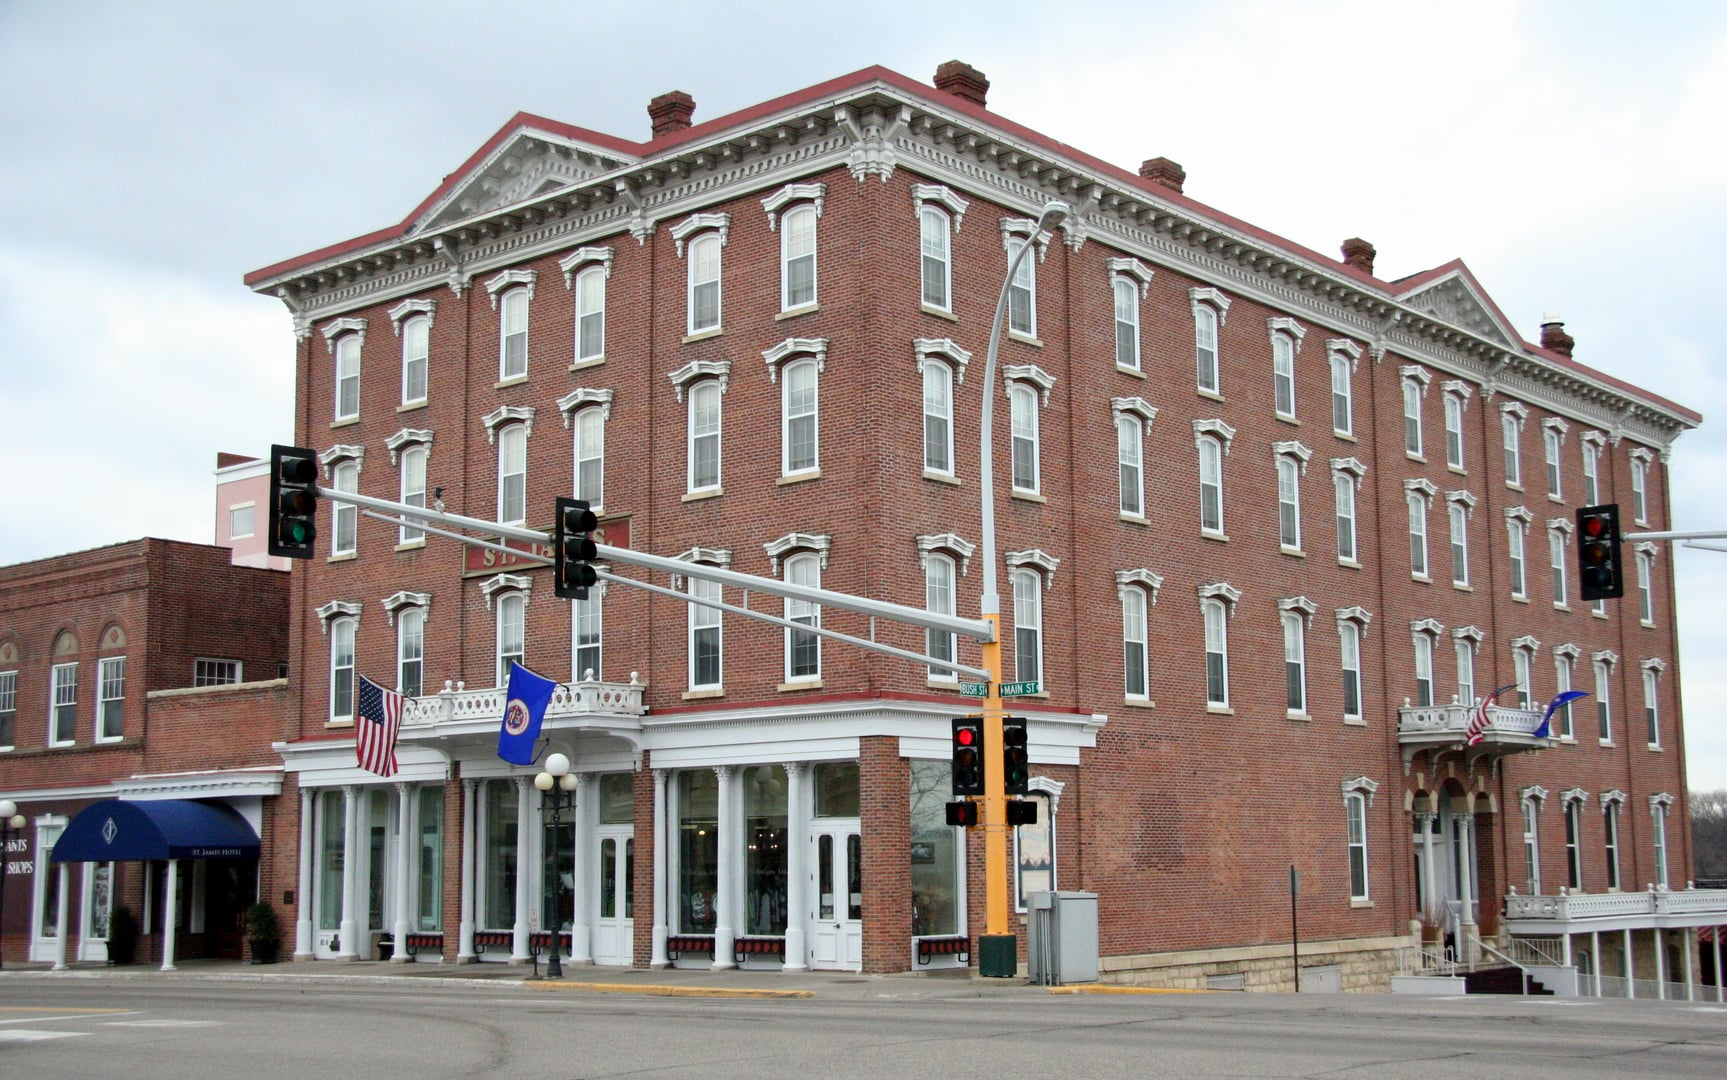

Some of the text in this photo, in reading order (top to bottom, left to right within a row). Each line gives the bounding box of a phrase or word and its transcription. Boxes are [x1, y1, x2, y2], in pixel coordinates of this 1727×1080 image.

[962, 683, 985, 695] BUSH ST
[1004, 682, 1035, 695] MAIN ST
[7, 861, 33, 874] SHOPS
